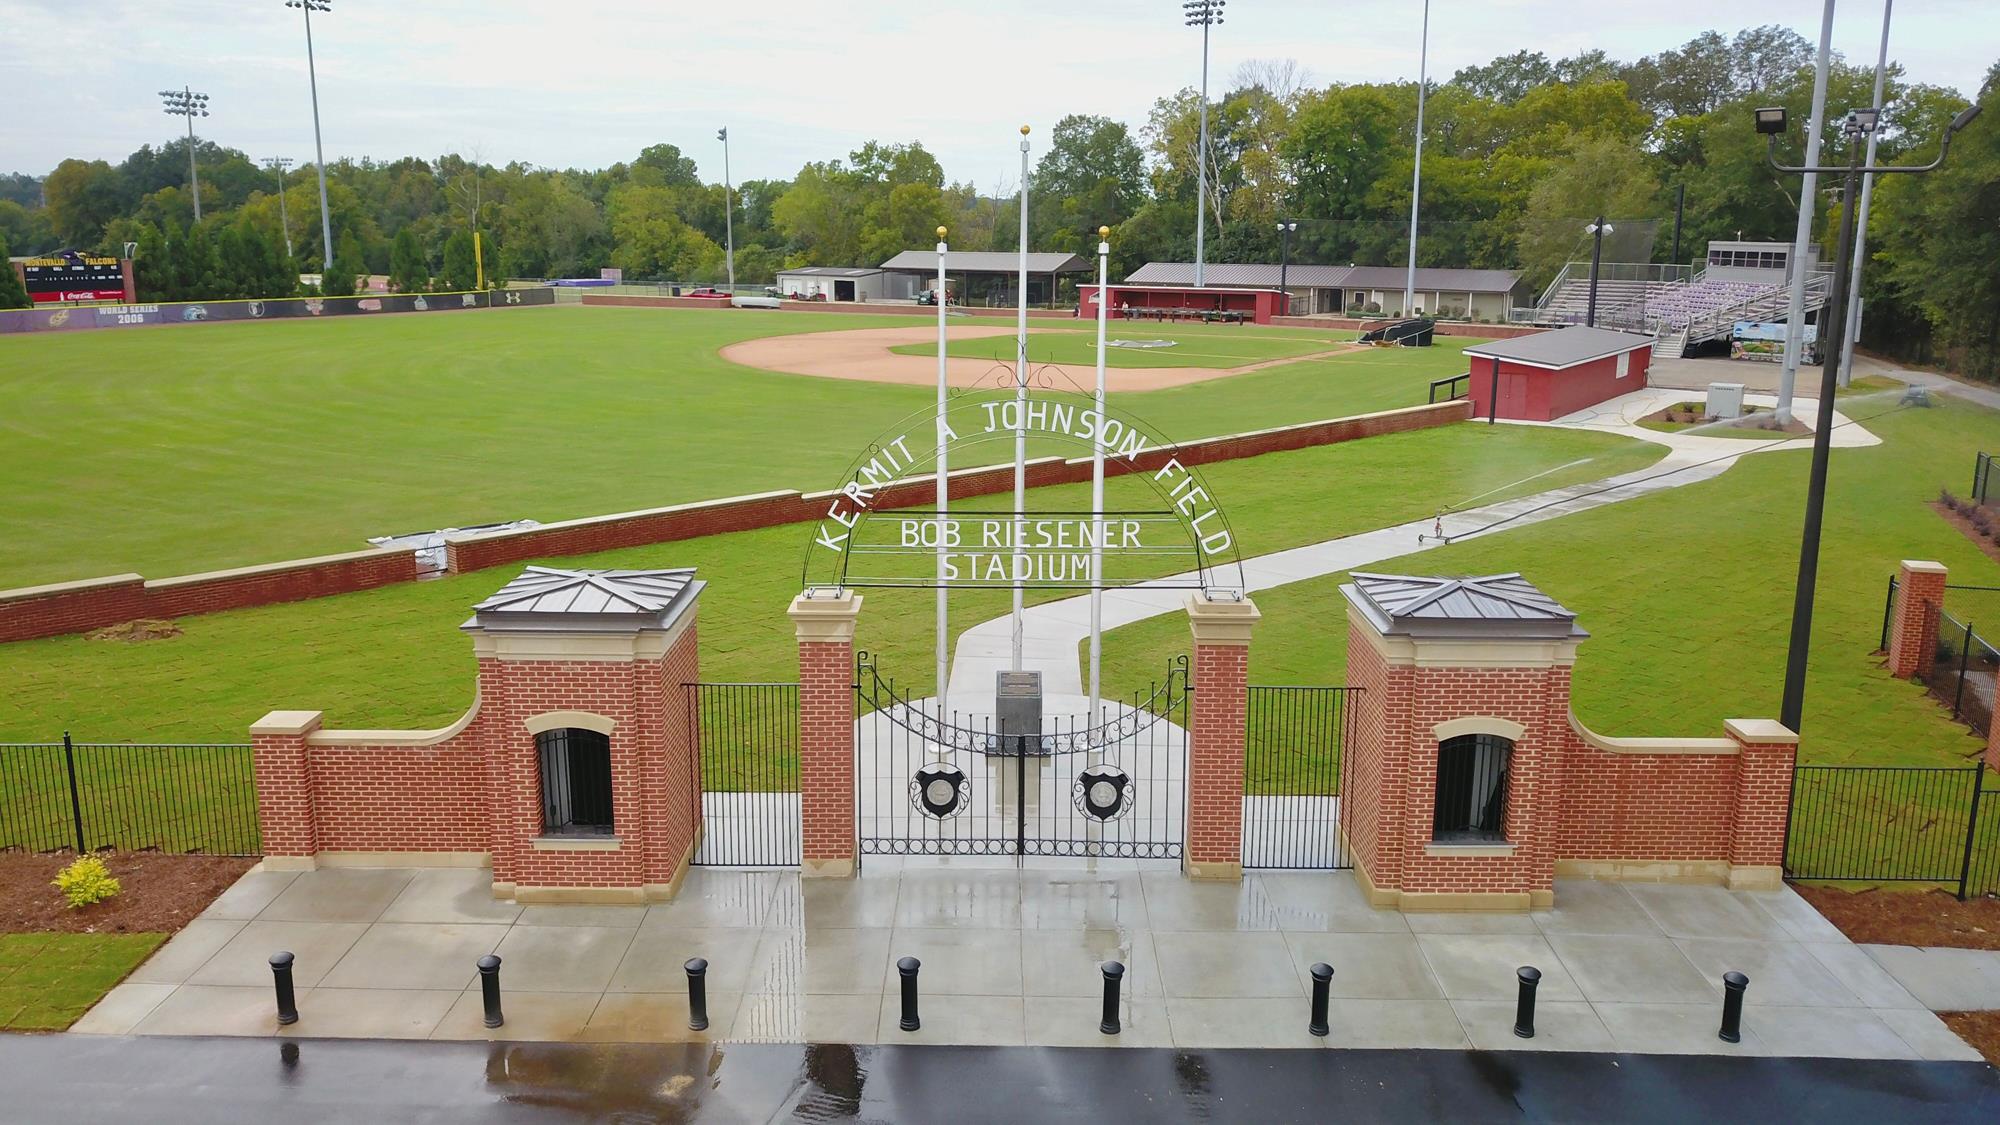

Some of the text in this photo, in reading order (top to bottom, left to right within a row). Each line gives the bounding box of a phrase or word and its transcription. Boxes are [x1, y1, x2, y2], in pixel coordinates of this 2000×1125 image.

[85, 257, 117, 266] FALCONS
[99, 305, 159, 315] WORLD SERIES
[815, 401, 1231, 555] KERMIT A JOHNSON FIELD
[901, 520, 1142, 548] BOB RIESENER
[942, 553, 1091, 581] STADIUM
